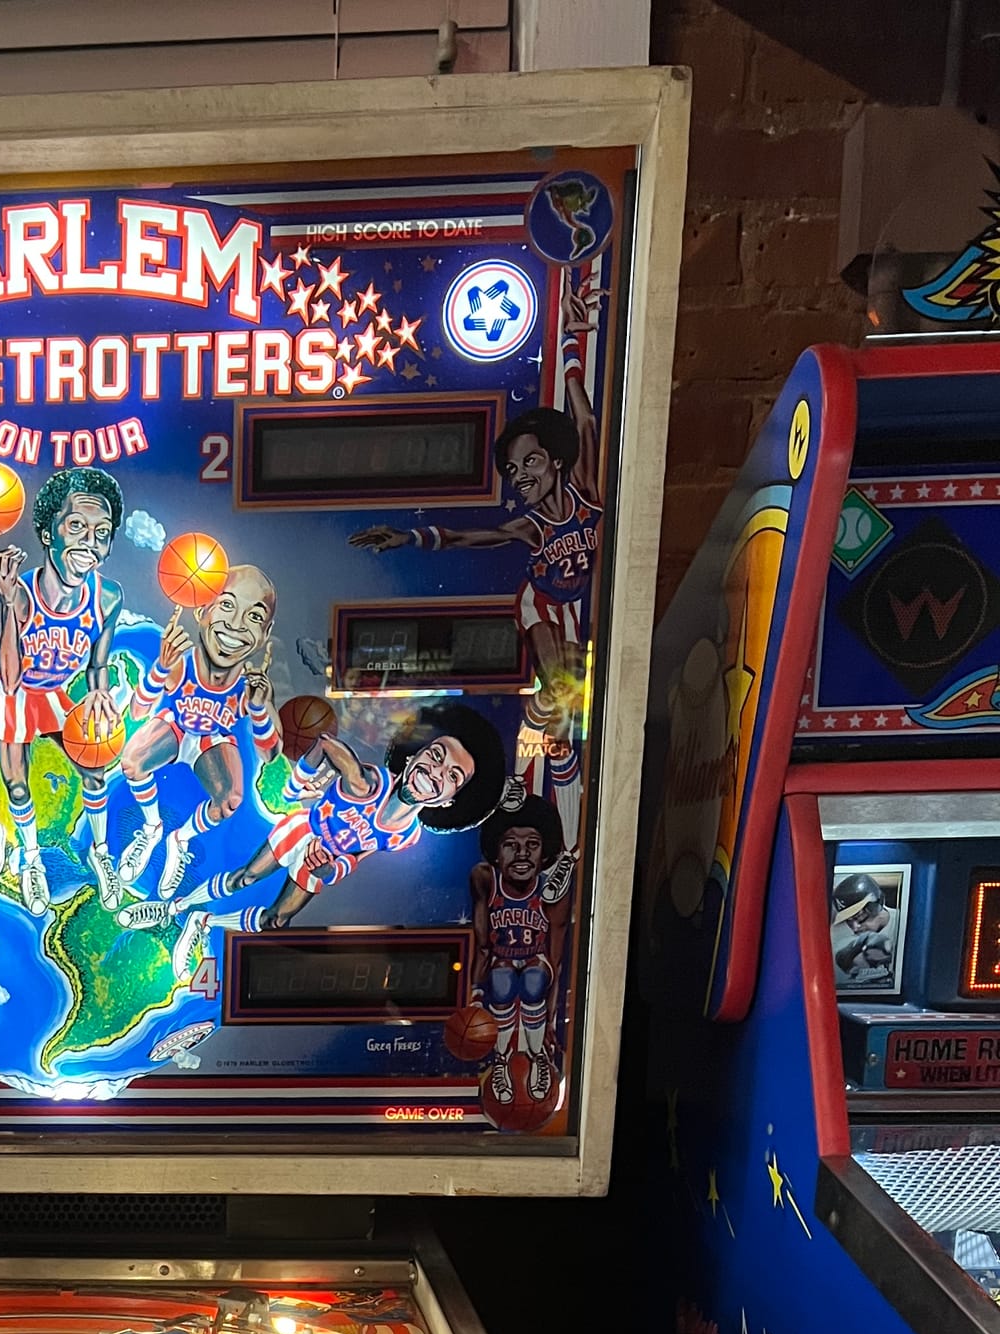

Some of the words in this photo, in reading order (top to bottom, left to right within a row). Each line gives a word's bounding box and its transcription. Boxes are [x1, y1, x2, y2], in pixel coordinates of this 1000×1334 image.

[306, 225, 347, 243] HIGH
[353, 221, 414, 241] SCORE
[416, 220, 437, 239] TO
[441, 218, 483, 238] DATE
[50, 416, 149, 467] TOUR
[201, 435, 229, 481] 2
[559, 552, 588, 578] 24
[40, 650, 70, 670] 35
[184, 712, 212, 732] 22
[518, 743, 569, 758] MATCH
[335, 829, 357, 851] 41
[508, 929, 532, 945] 18
[190, 957, 220, 999] 4
[894, 1038, 967, 1061] HOME
[919, 1066, 971, 1082] WHEN
[384, 1106, 425, 1120] GAME
[428, 1106, 464, 1121] OVER
